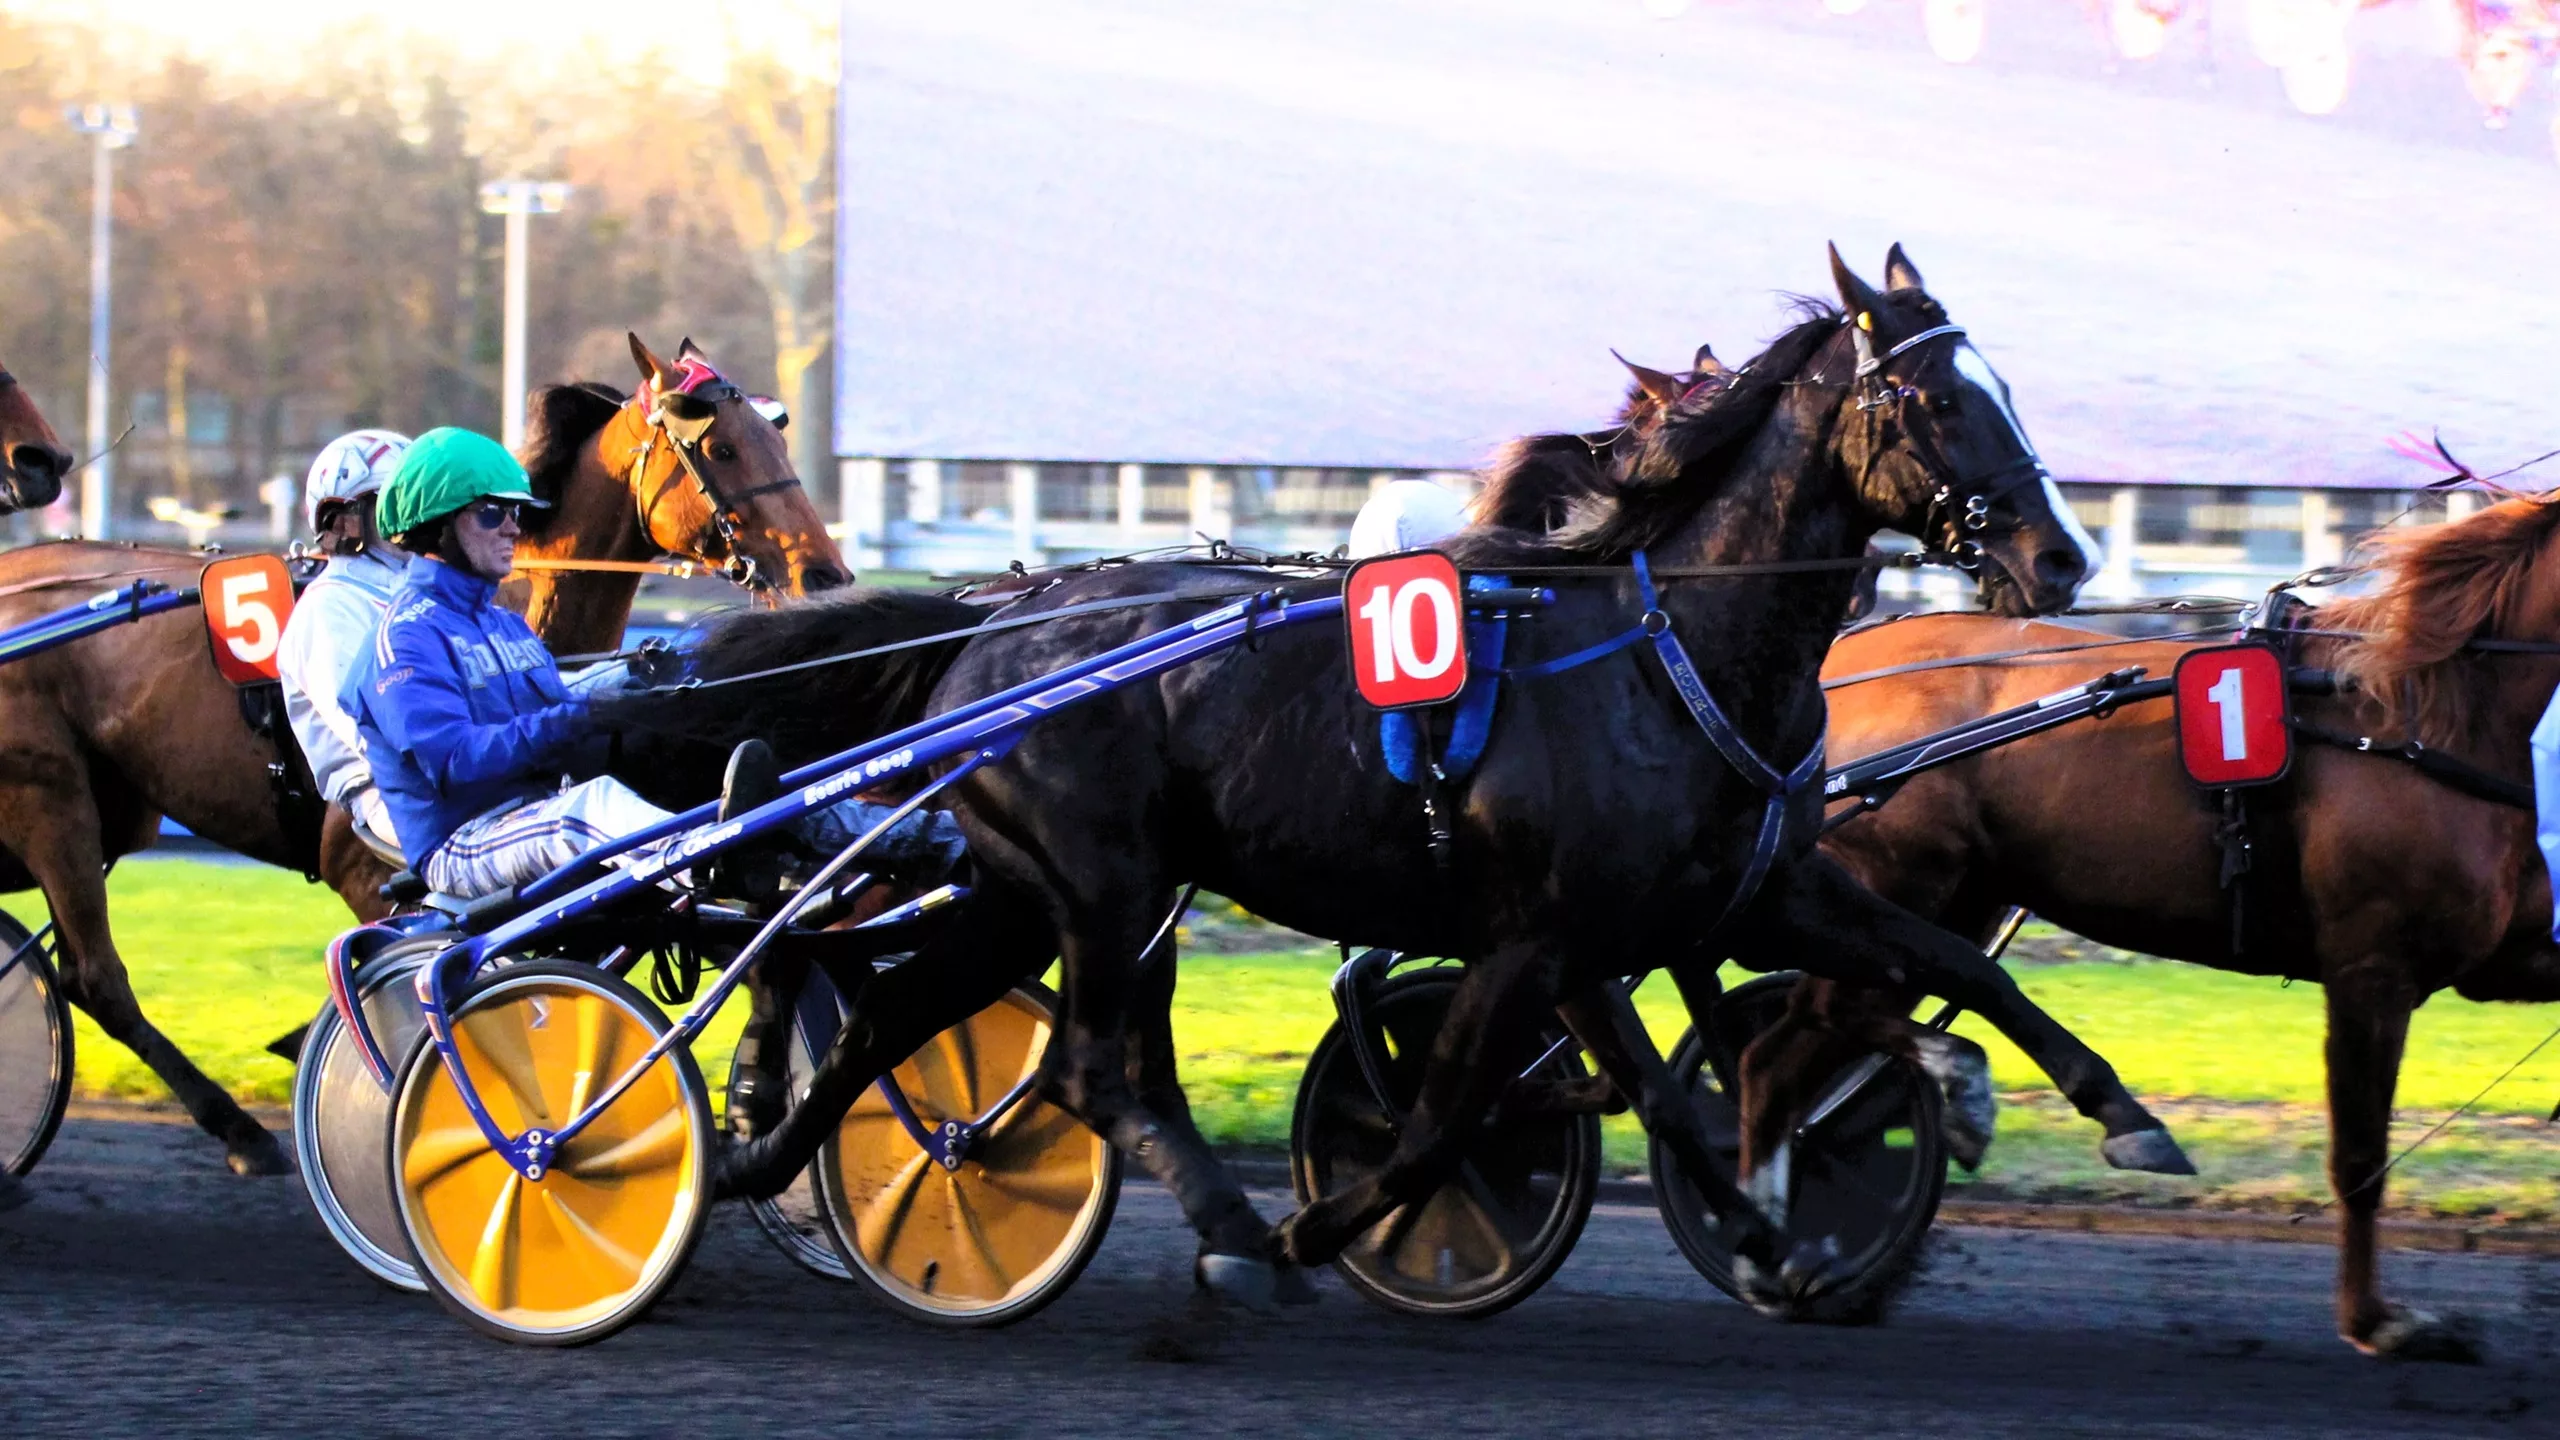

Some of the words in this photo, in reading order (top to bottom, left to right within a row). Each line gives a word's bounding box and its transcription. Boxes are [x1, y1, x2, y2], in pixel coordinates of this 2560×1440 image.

[222, 571, 279, 664] 5
[1359, 577, 1458, 683] 10
[2208, 668, 2247, 761] 1
[804, 770, 861, 807] Ecurie
